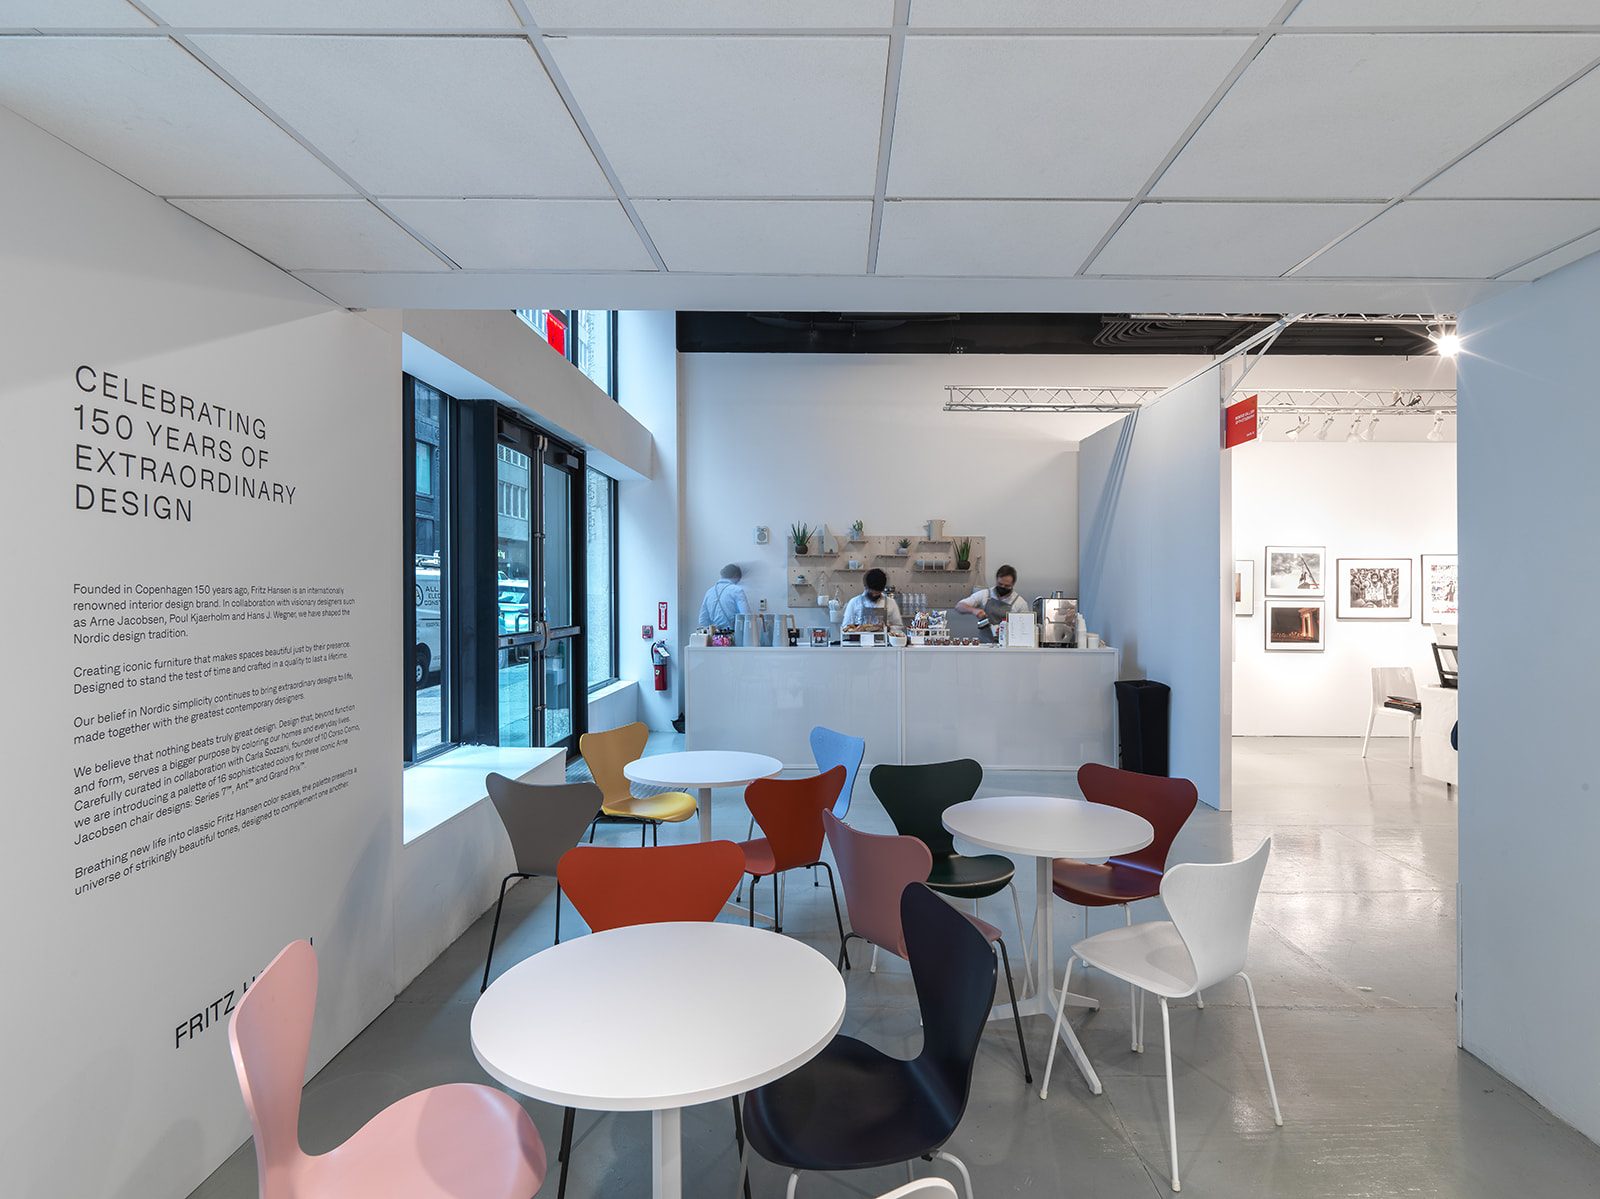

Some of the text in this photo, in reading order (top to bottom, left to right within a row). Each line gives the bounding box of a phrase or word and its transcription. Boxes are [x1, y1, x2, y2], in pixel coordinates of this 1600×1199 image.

[75, 365, 267, 440] CELEBRATING
[73, 404, 269, 469] 150 YEARS OF
[76, 444, 296, 505] EXTRAORDINARY
[75, 484, 192, 522] DESIGN
[73, 600, 127, 611] renowned
[129, 599, 163, 610] interior
[165, 599, 194, 612] design
[196, 598, 221, 609] brand.
[222, 598, 230, 608] In
[231, 598, 275, 608] collaboration
[74, 583, 121, 595] Founded
[124, 584, 133, 594] in
[135, 584, 193, 597] Copenhagen
[195, 585, 210, 595] 150
[212, 587, 232, 597] years
[234, 587, 249, 597] ago,
[251, 585, 266, 594] Fritz
[73, 619, 87, 628] as
[89, 616, 115, 627] Arne
[117, 615, 167, 626] Jacobsen,
[170, 613, 189, 623] Poul
[190, 612, 230, 625] Kjaerholm
[231, 611, 245, 621] and
[247, 610, 264, 620] Hans
[74, 628, 188, 644] Nordic design tradition.
[73, 664, 122, 678] Creating
[123, 660, 152, 673] iconic
[154, 657, 192, 670] furniture
[194, 655, 211, 665] that
[212, 652, 237, 662] makes
[238, 650, 264, 662] spaces
[74, 678, 124, 695] Designed
[127, 677, 137, 687] to
[140, 673, 167, 686] stand
[169, 672, 183, 682] the
[185, 669, 202, 680] test
[204, 667, 213, 678] of
[213, 666, 231, 676] time
[232, 663, 246, 674] and
[247, 660, 271, 672] crafted
[74, 716, 95, 728] Our
[97, 709, 126, 724] belief
[128, 708, 137, 719] in
[140, 703, 170, 716] Nordic
[172, 696, 213, 711] simplicity
[214, 690, 250, 704] continues
[251, 689, 259, 697] to
[74, 698, 274, 744] made together with the greatest contemporary
[74, 766, 92, 778] We
[94, 757, 131, 773] believe
[133, 751, 153, 764] that
[155, 743, 190, 760] nothing
[191, 737, 214, 750] beats
[215, 733, 233, 744] truly
[234, 728, 253, 742] great
[74, 780, 95, 795] and
[98, 775, 126, 789] form,
[128, 765, 160, 781] serves
[162, 763, 168, 772] a
[170, 756, 196, 770] bigger
[198, 747, 230, 764] purpose
[231, 744, 240, 754] by
[241, 737, 269, 752] coloring
[74, 790, 123, 812] Carefully
[124, 778, 161, 798] curated
[164, 776, 172, 786] in
[174, 762, 226, 783] collaboration
[227, 756, 244, 767] with
[245, 751, 263, 763] Carla
[74, 816, 91, 828] we
[94, 810, 111, 823] are
[113, 792, 169, 817] introducing
[170, 791, 176, 799] a
[178, 781, 207, 799] palette
[208, 776, 217, 787] of
[218, 773, 227, 784] 16
[228, 759, 275, 781] sophisticated
[74, 821, 127, 845] Jacobsen
[129, 811, 154, 827] chair
[156, 800, 193, 818] designs:
[194, 791, 219, 805] Series
[75, 852, 128, 879] Breathing
[130, 844, 151, 858] new
[153, 837, 167, 850] life
[169, 831, 186, 844] into
[187, 820, 215, 837] classic
[217, 813, 234, 825] Fritz
[235, 802, 262, 819] Hansen
[75, 869, 121, 895] universe
[123, 863, 134, 876] of
[136, 848, 178, 872] strikingly
[179, 831, 216, 854] beautiful
[217, 824, 240, 839] tones,
[241, 809, 272, 829] designed
[175, 990, 235, 1049] FRITZ
